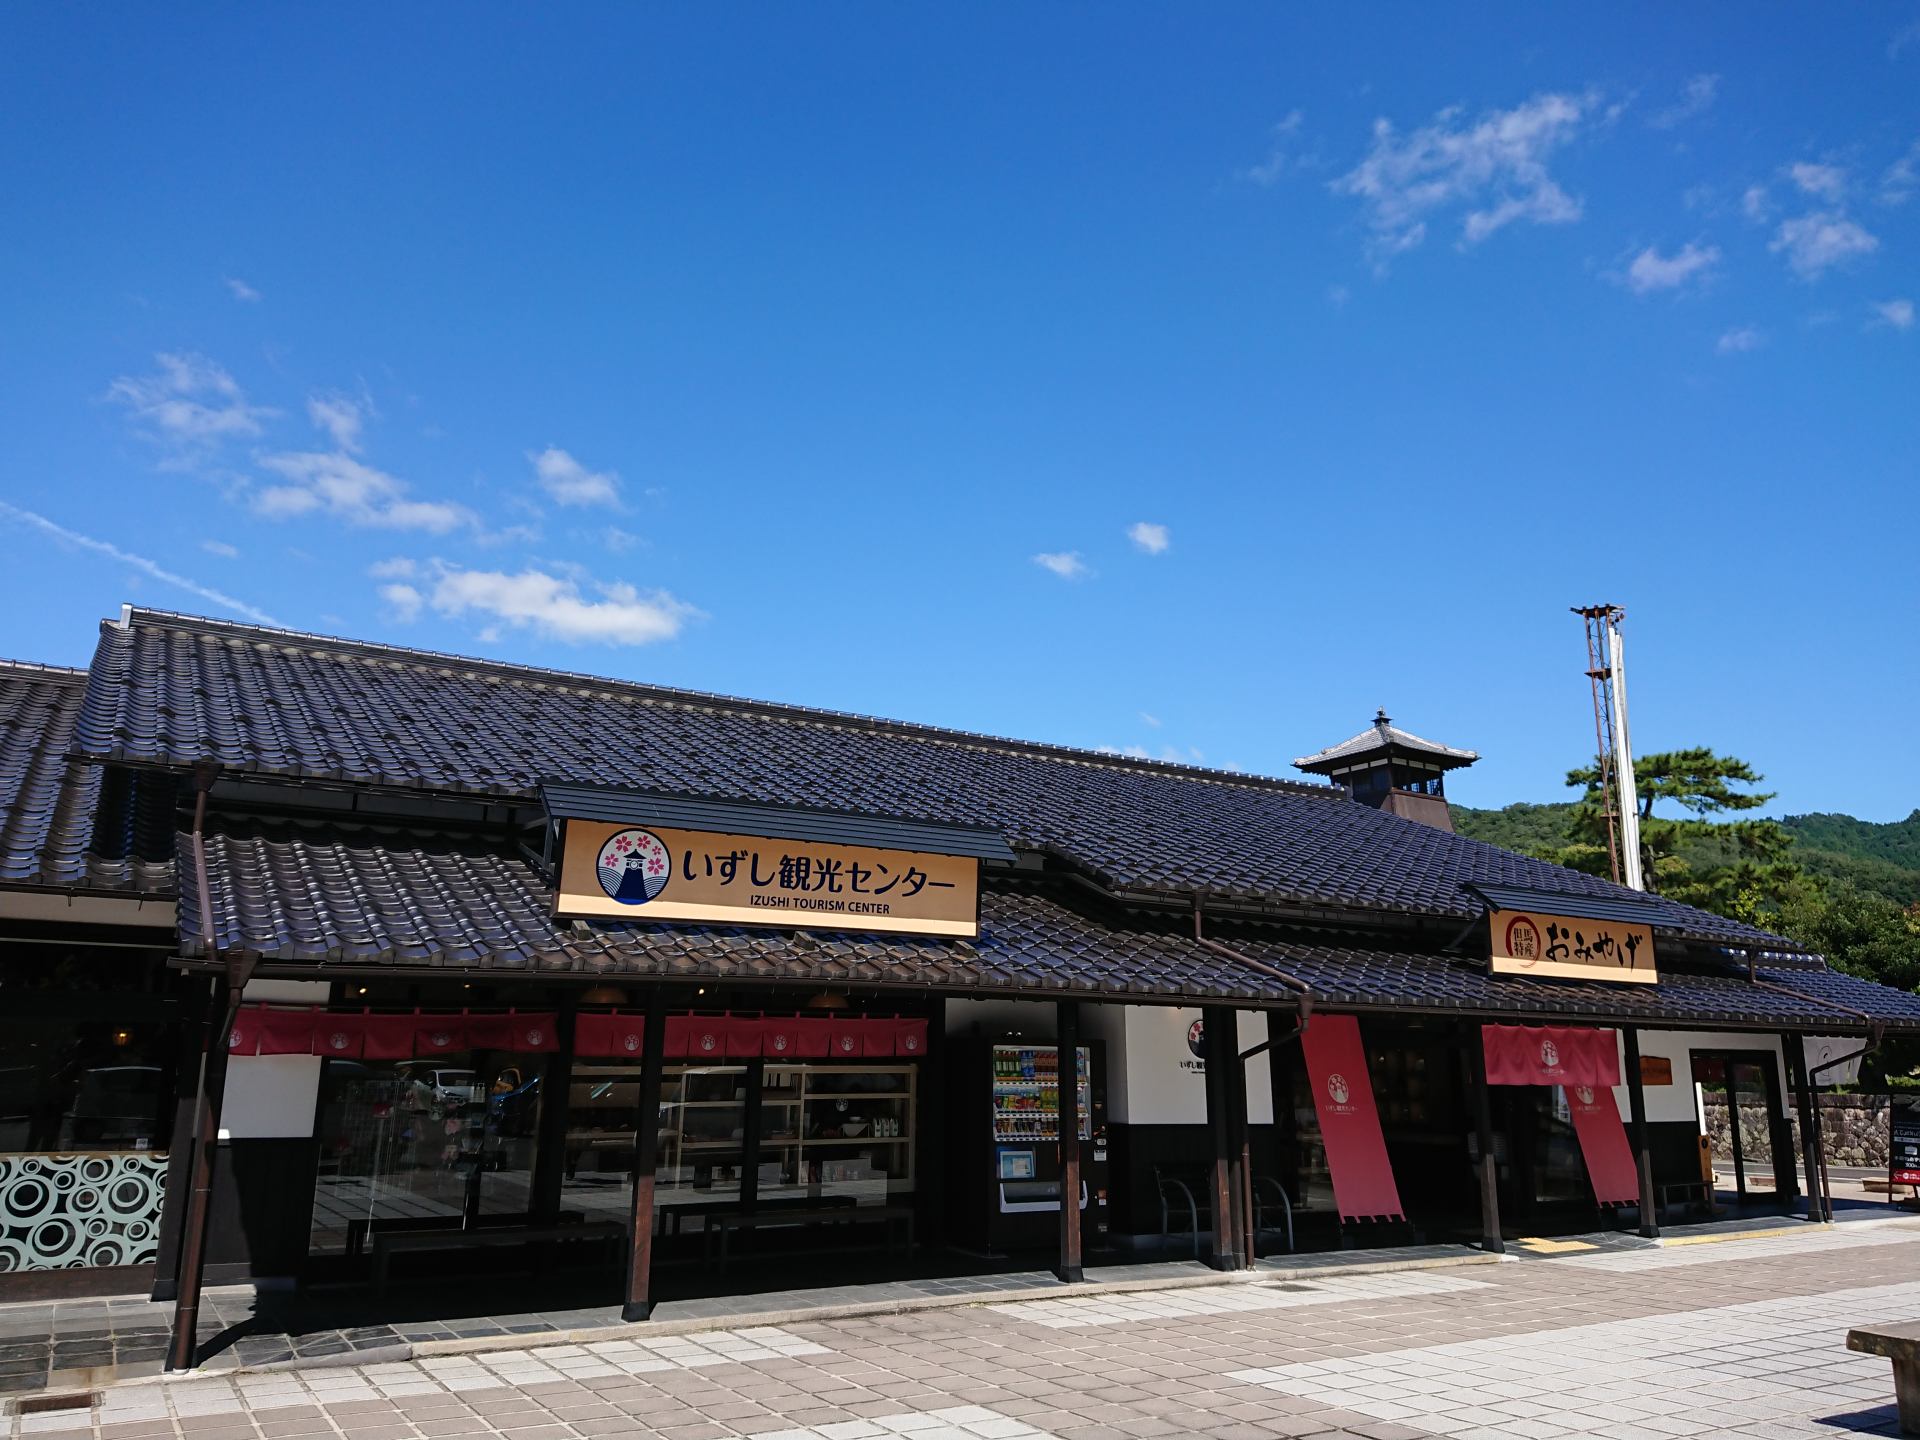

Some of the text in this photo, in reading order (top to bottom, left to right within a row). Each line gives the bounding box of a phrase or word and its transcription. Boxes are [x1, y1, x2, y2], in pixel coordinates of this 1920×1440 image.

[683, 850, 956, 897] いずし観光センター
[750, 895, 890, 914] IZUSHI TOURISM CENTER
[1545, 922, 1643, 973] おみやげ
